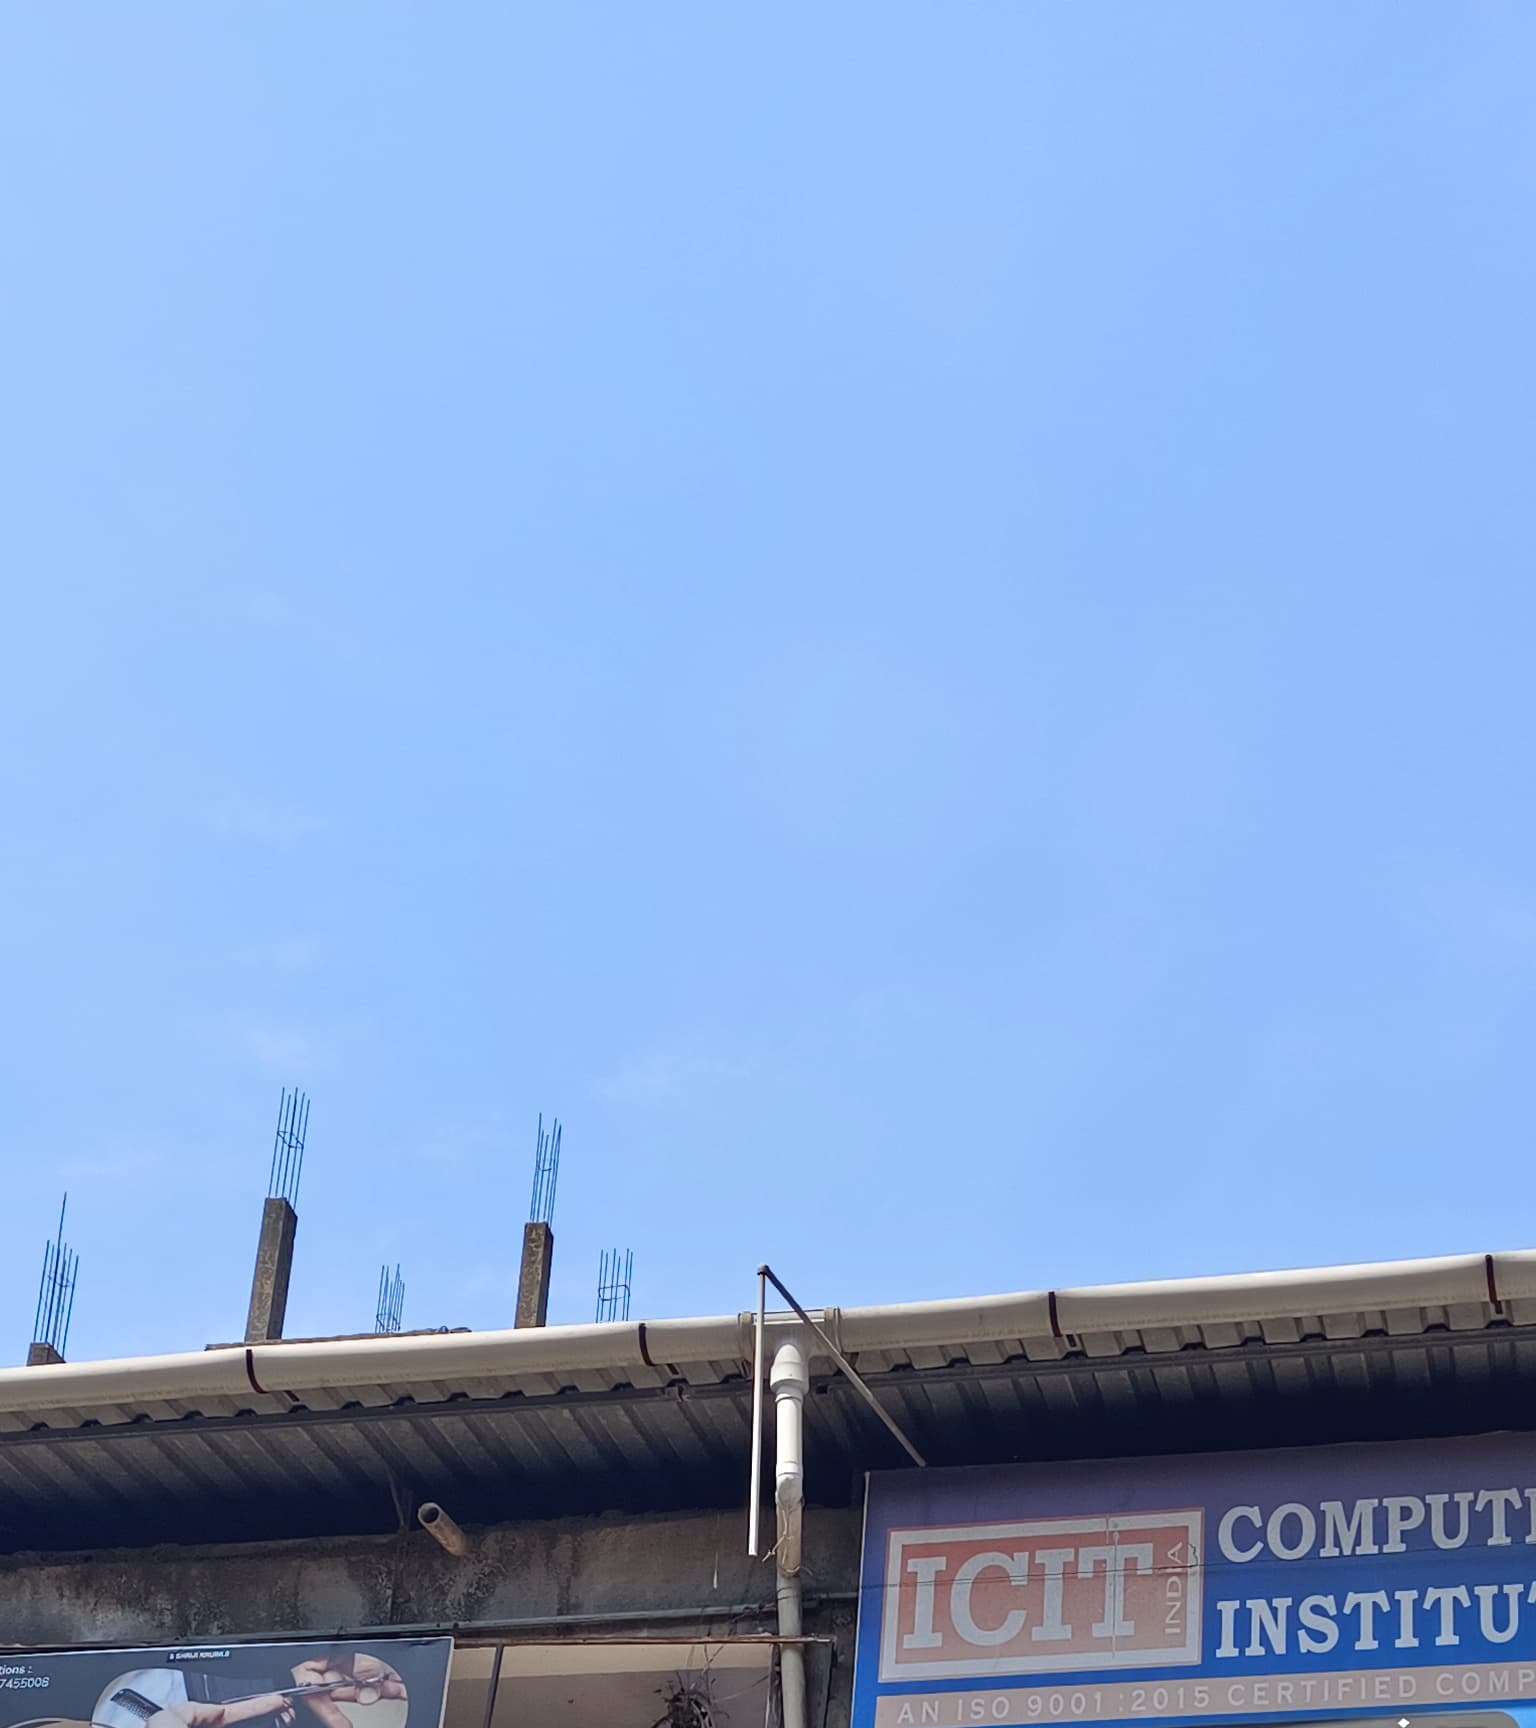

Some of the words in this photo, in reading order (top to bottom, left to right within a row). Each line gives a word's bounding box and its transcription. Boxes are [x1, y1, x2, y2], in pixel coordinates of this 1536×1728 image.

[902, 1542, 1154, 1649] ICIT
[1165, 1541, 1184, 1634] INDIA
[897, 1700, 939, 1725] AN
[957, 1697, 1010, 1721] ISO
[1228, 1675, 1417, 1706] CERTIFIED
